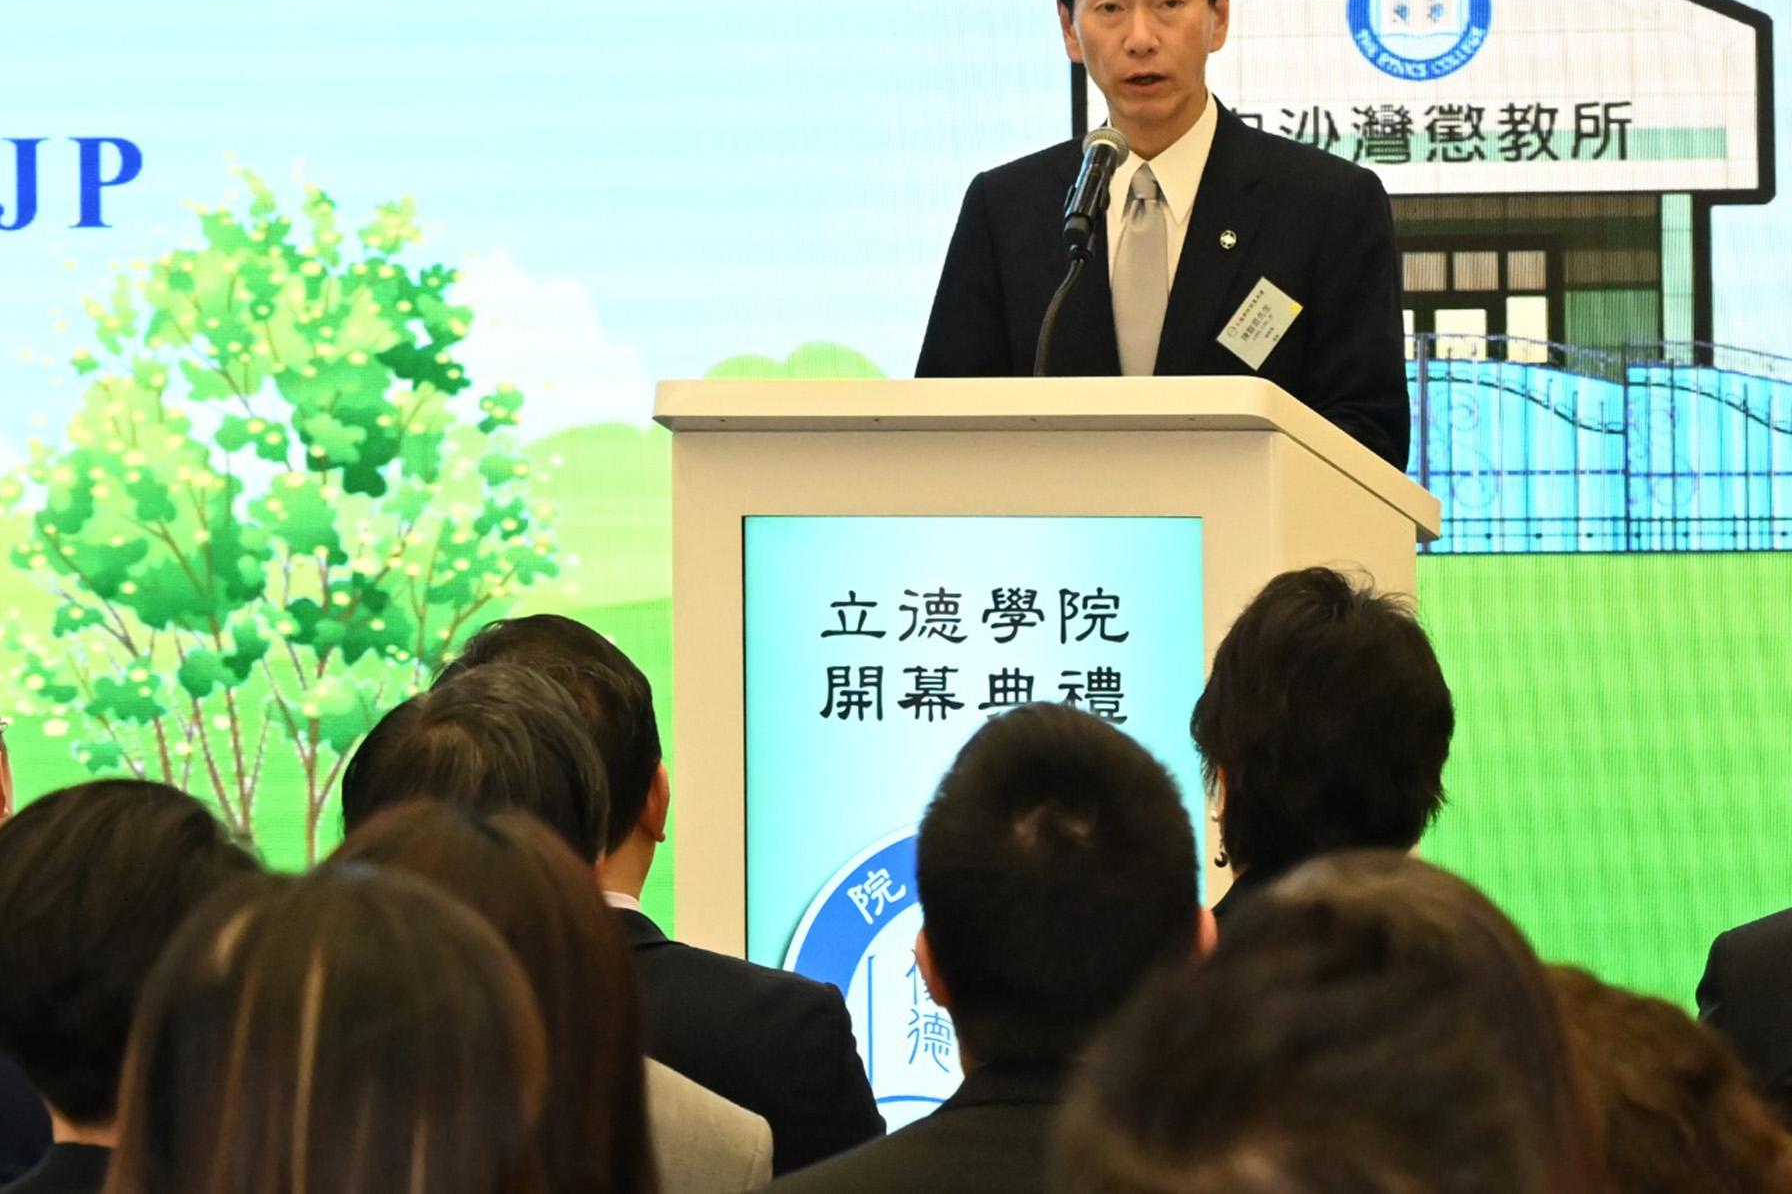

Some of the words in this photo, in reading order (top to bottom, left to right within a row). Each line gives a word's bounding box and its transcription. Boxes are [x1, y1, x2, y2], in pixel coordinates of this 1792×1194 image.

[819, 586, 1130, 645] 立德學院
[818, 664, 1130, 725] 開幕典禮
[846, 866, 907, 925] 院
